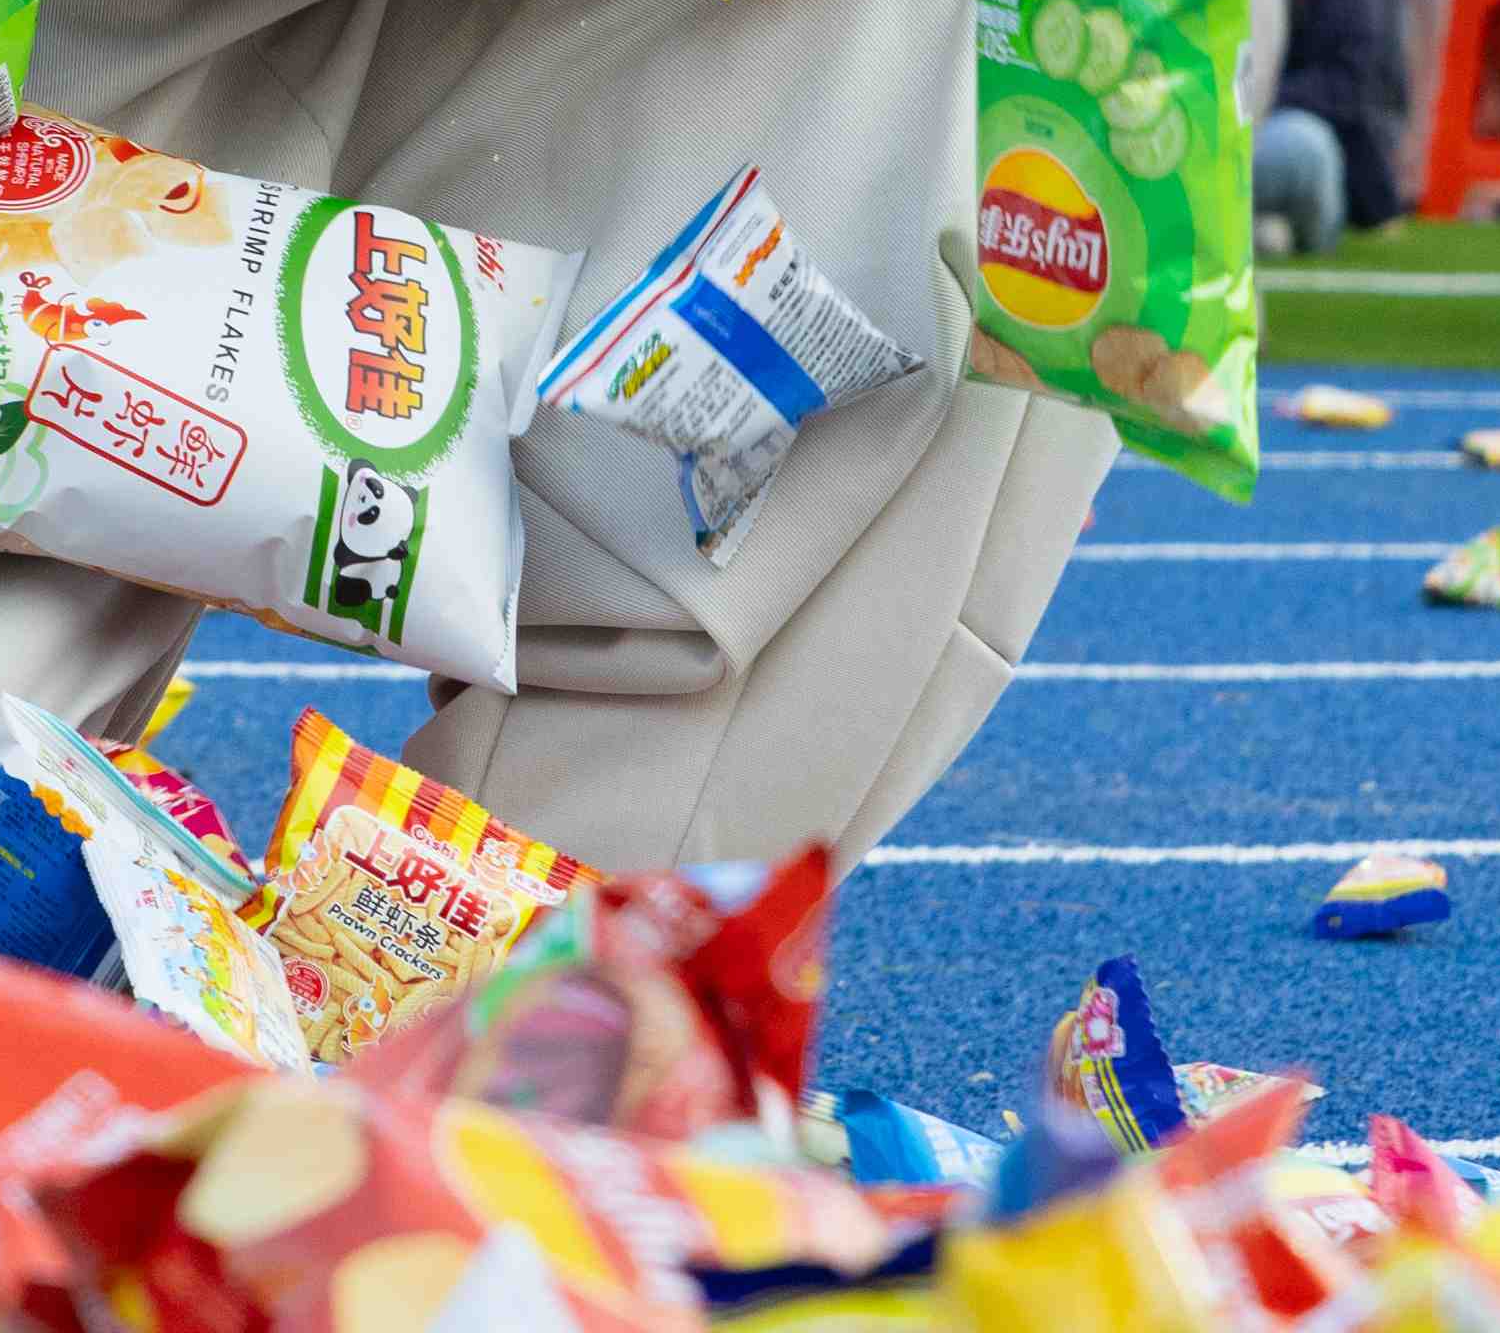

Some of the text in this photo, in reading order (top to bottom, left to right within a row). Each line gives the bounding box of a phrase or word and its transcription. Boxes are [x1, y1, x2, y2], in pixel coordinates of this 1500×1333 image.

[30, 141, 46, 189] NATURAL
[57, 151, 72, 182] MADE
[239, 180, 283, 277] SHRIMP
[206, 286, 256, 404] FLAKES
[344, 210, 433, 422] 上好佳
[41, 365, 227, 494] 鲜虾片
[343, 826, 493, 942] 上好佳
[410, 823, 461, 862] Oishi
[328, 902, 446, 984] Prawn Crackers
[351, 885, 446, 956] 鲜虾条
